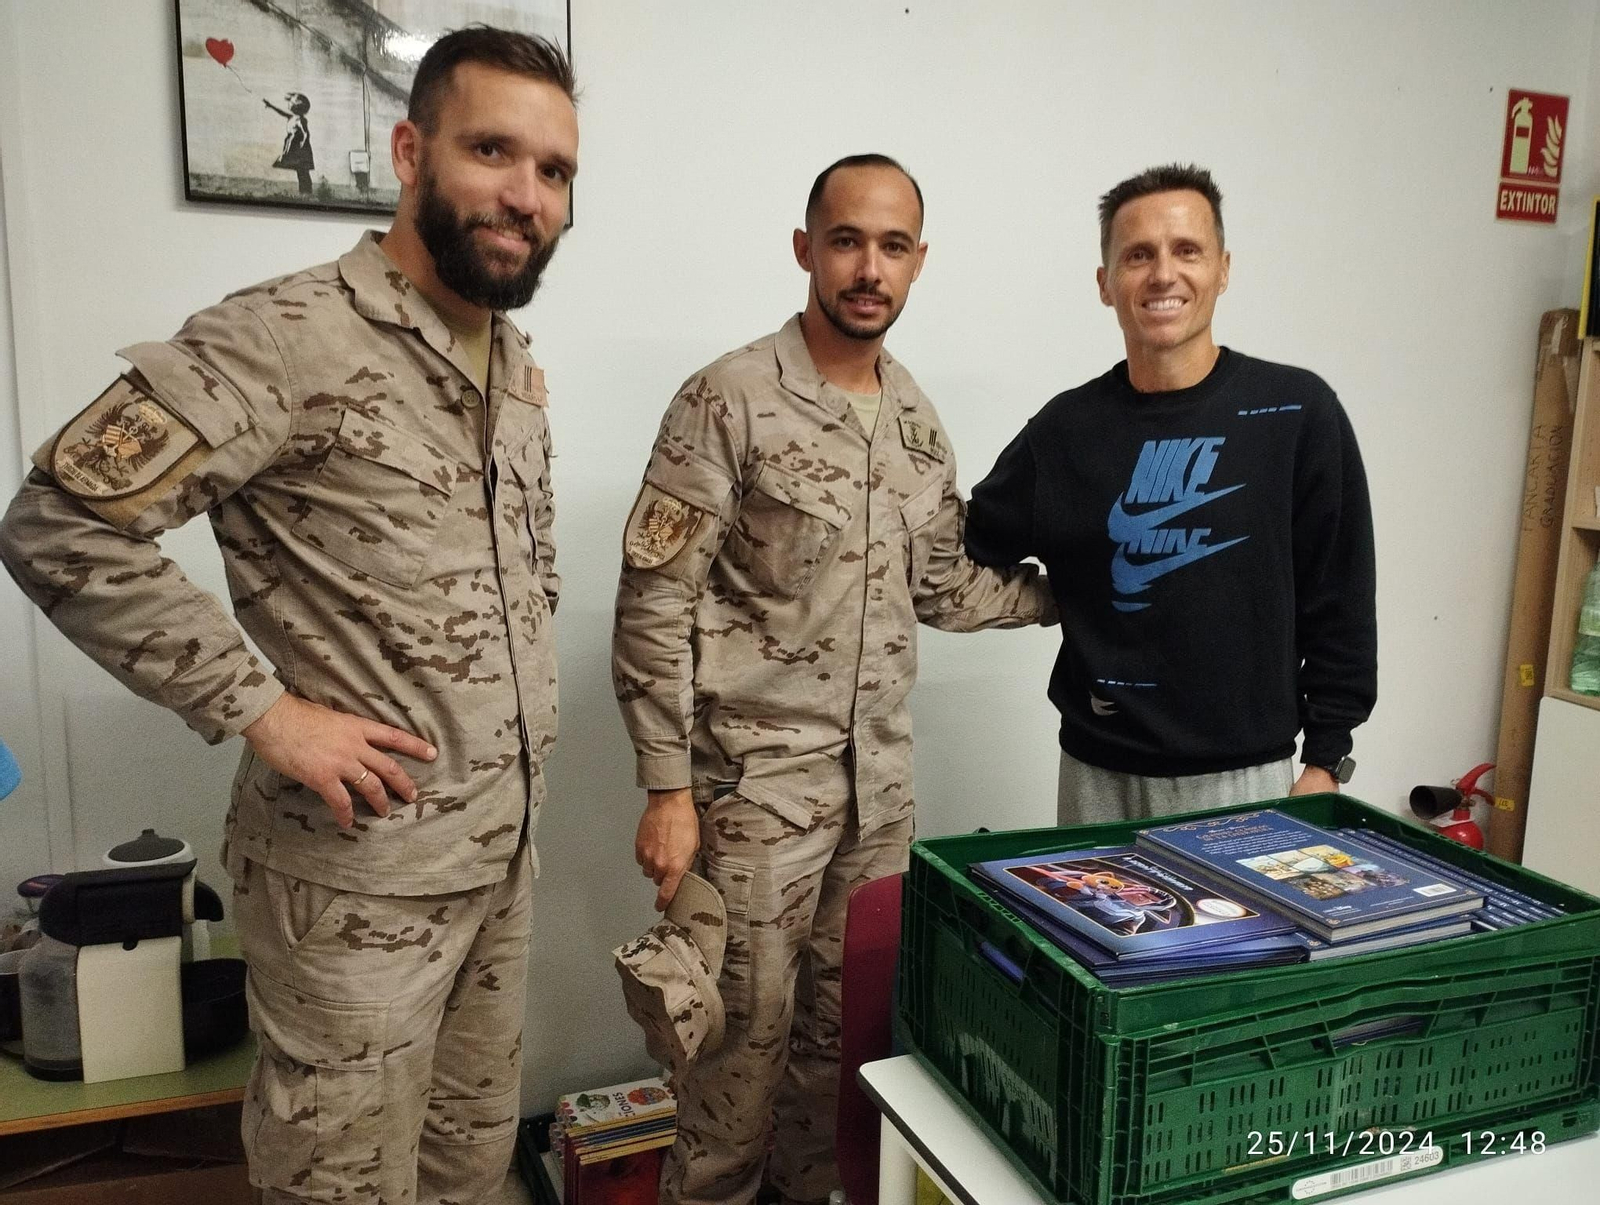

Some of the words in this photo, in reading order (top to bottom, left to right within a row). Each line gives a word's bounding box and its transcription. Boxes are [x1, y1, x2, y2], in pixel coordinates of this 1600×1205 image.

[1500, 189, 1556, 215] EXTINTOR
[1125, 437, 1226, 504] NIKE
[612, 1091, 636, 1118] IONES
[1414, 1151, 1440, 1165] 24603
